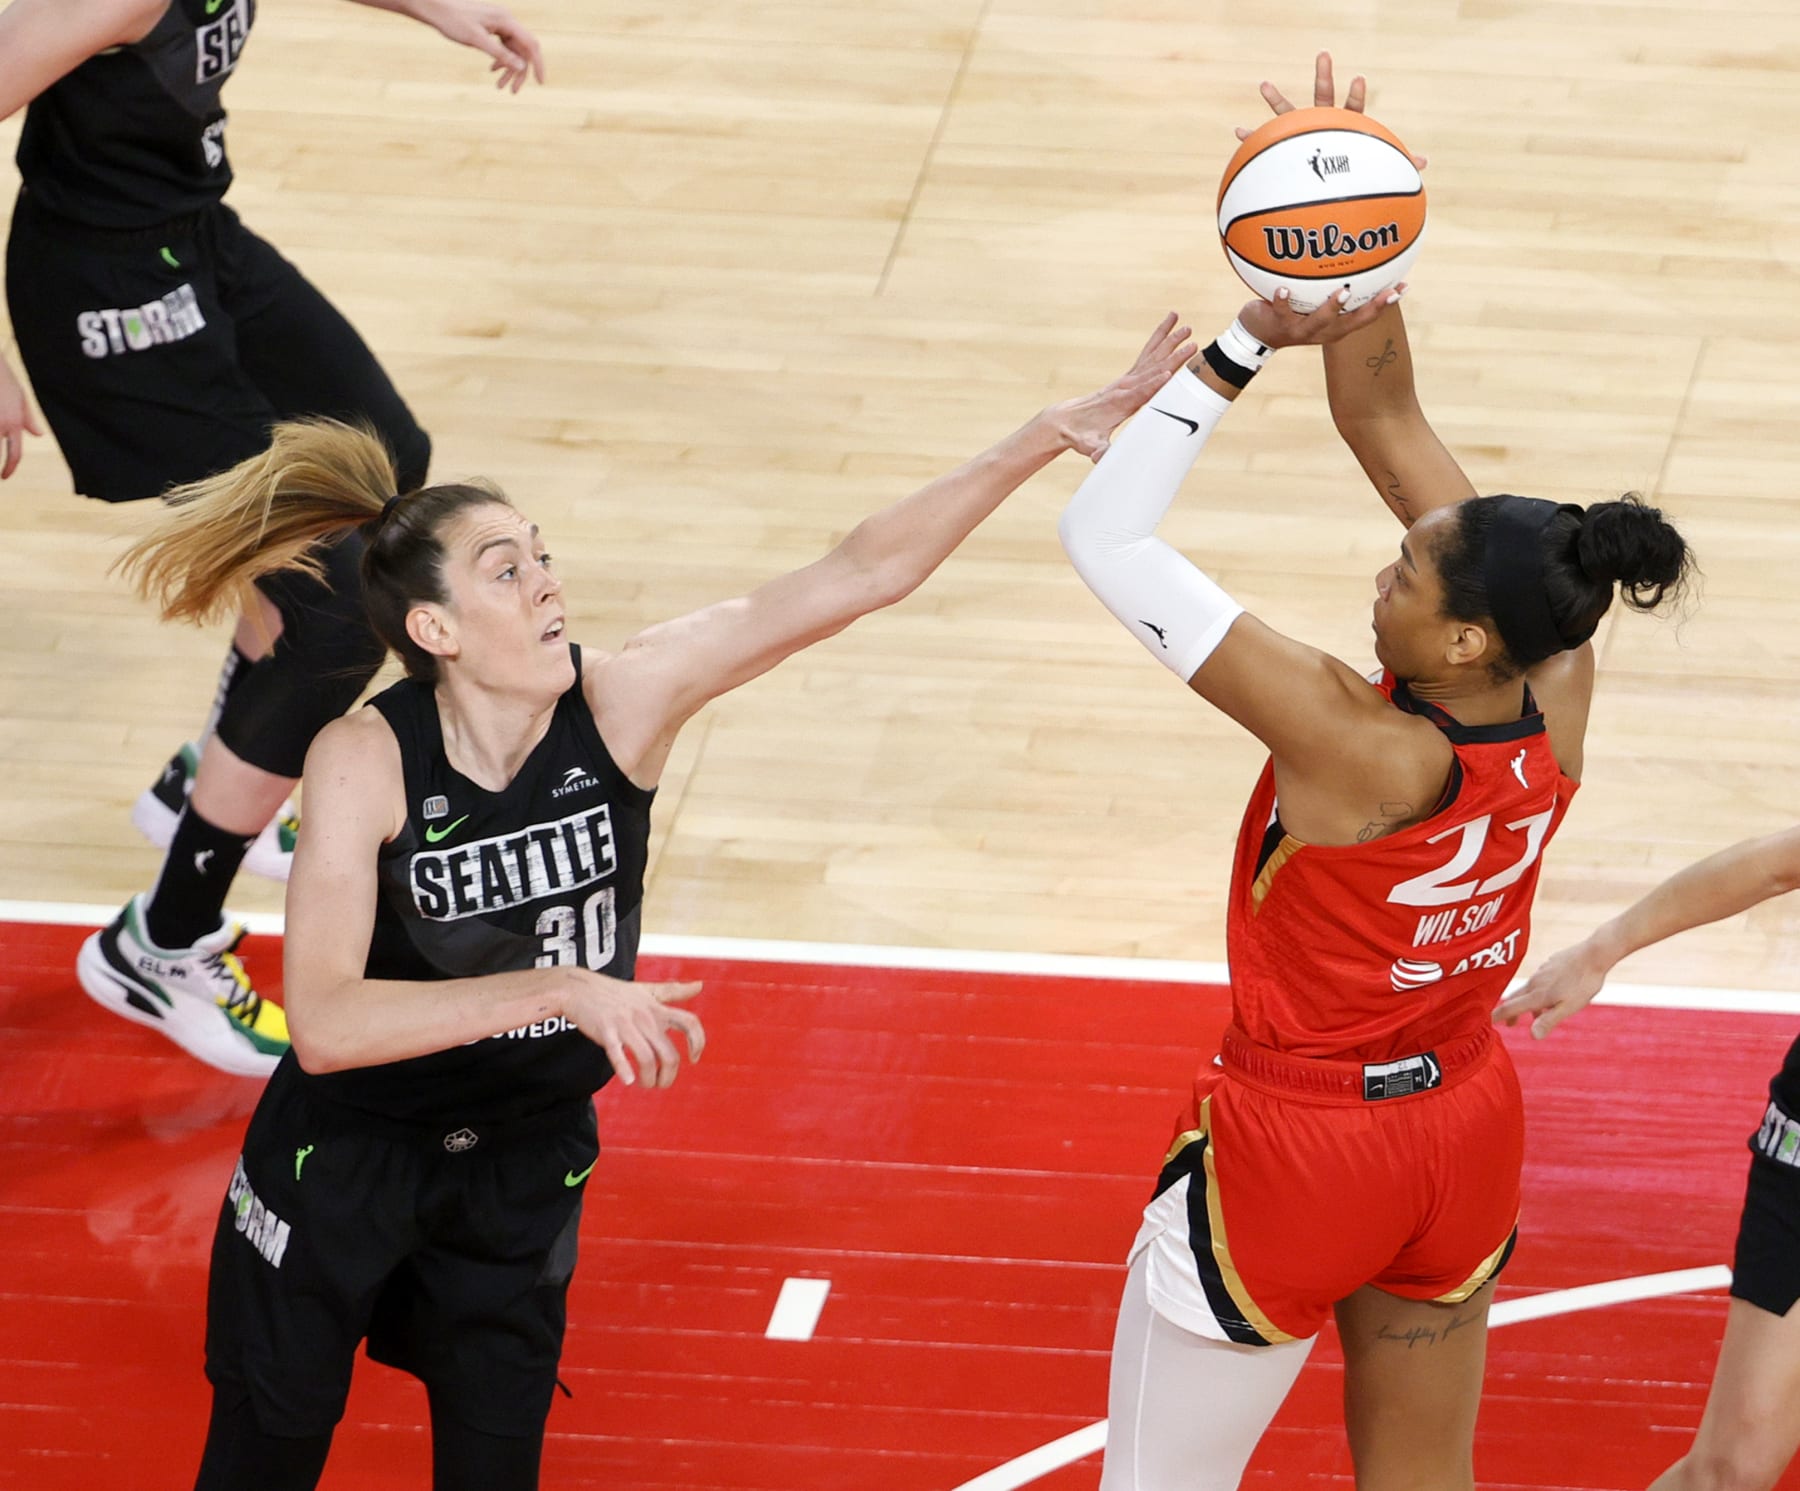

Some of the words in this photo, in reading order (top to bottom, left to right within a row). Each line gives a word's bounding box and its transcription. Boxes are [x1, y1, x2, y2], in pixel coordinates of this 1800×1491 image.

[1262, 222, 1400, 261] Wilson
[77, 283, 207, 359] STORM
[551, 776, 600, 799] SYMETRA
[411, 805, 617, 921] SEATTLE
[534, 886, 617, 972] 30
[1412, 893, 1505, 948] WILSON
[1449, 928, 1521, 977] AT&T
[491, 1015, 578, 1040] WEDI
